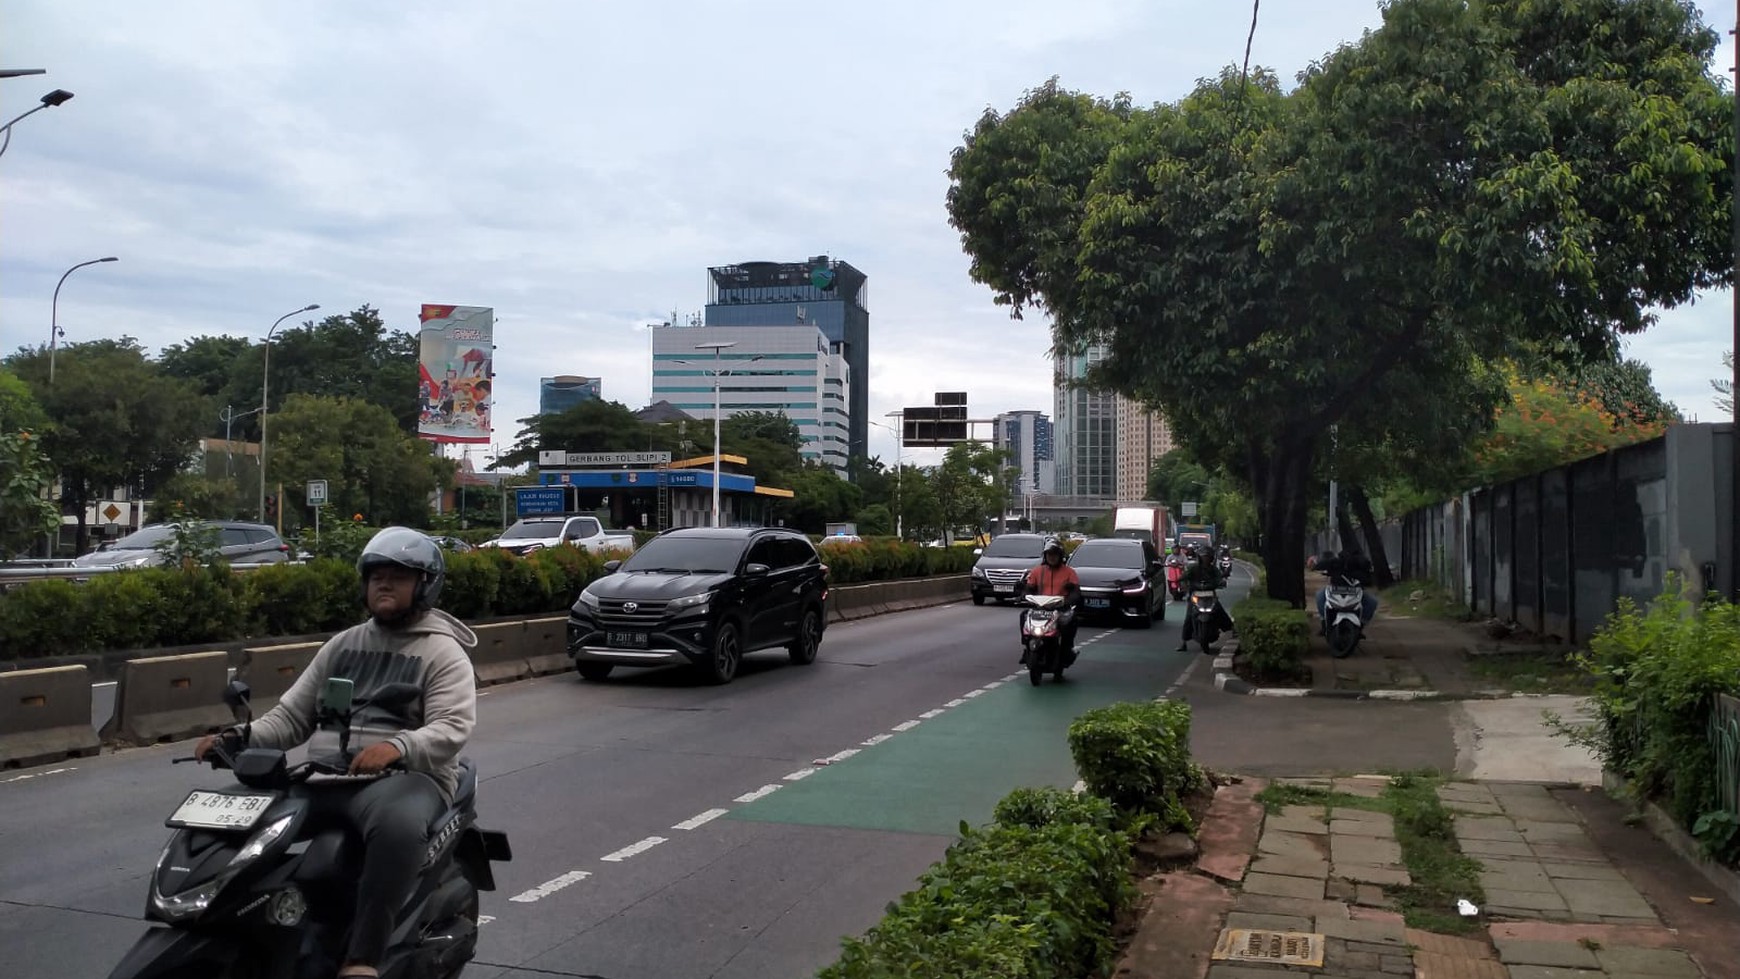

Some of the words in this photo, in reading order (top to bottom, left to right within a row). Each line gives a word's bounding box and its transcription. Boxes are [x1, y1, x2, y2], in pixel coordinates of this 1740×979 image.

[569, 455, 611, 463] GERBANG
[636, 454, 658, 462] SLIPI
[661, 453, 667, 461] 2
[186, 793, 199, 806] B
[200, 795, 238, 808] 4876
[239, 797, 268, 811] EBI
[428, 814, 460, 858] STREET
[237, 894, 270, 916] HONDA
